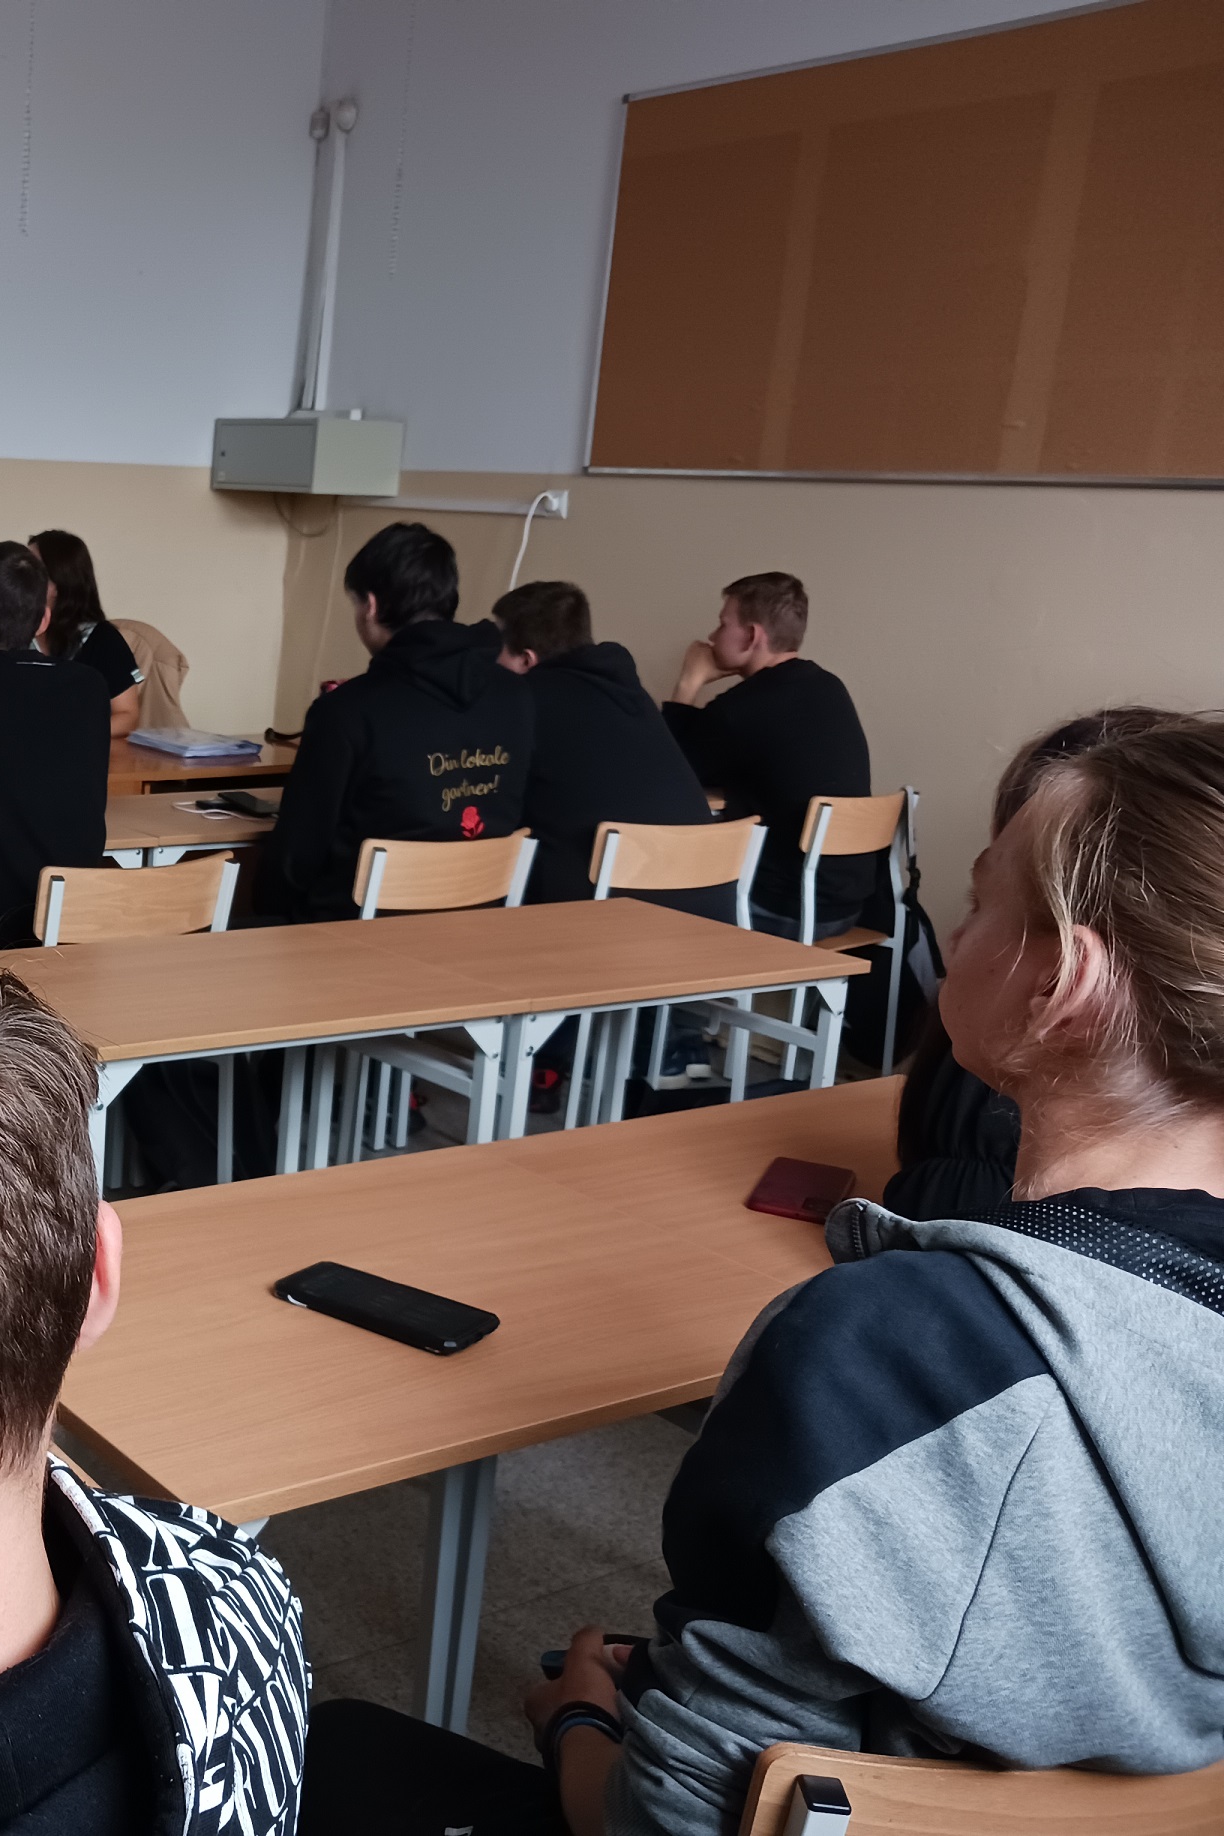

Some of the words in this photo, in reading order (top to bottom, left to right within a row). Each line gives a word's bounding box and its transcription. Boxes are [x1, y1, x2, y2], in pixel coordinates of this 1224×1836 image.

[427, 752, 458, 776] Din
[461, 745, 509, 768] lokale
[441, 774, 500, 812] gartner!
